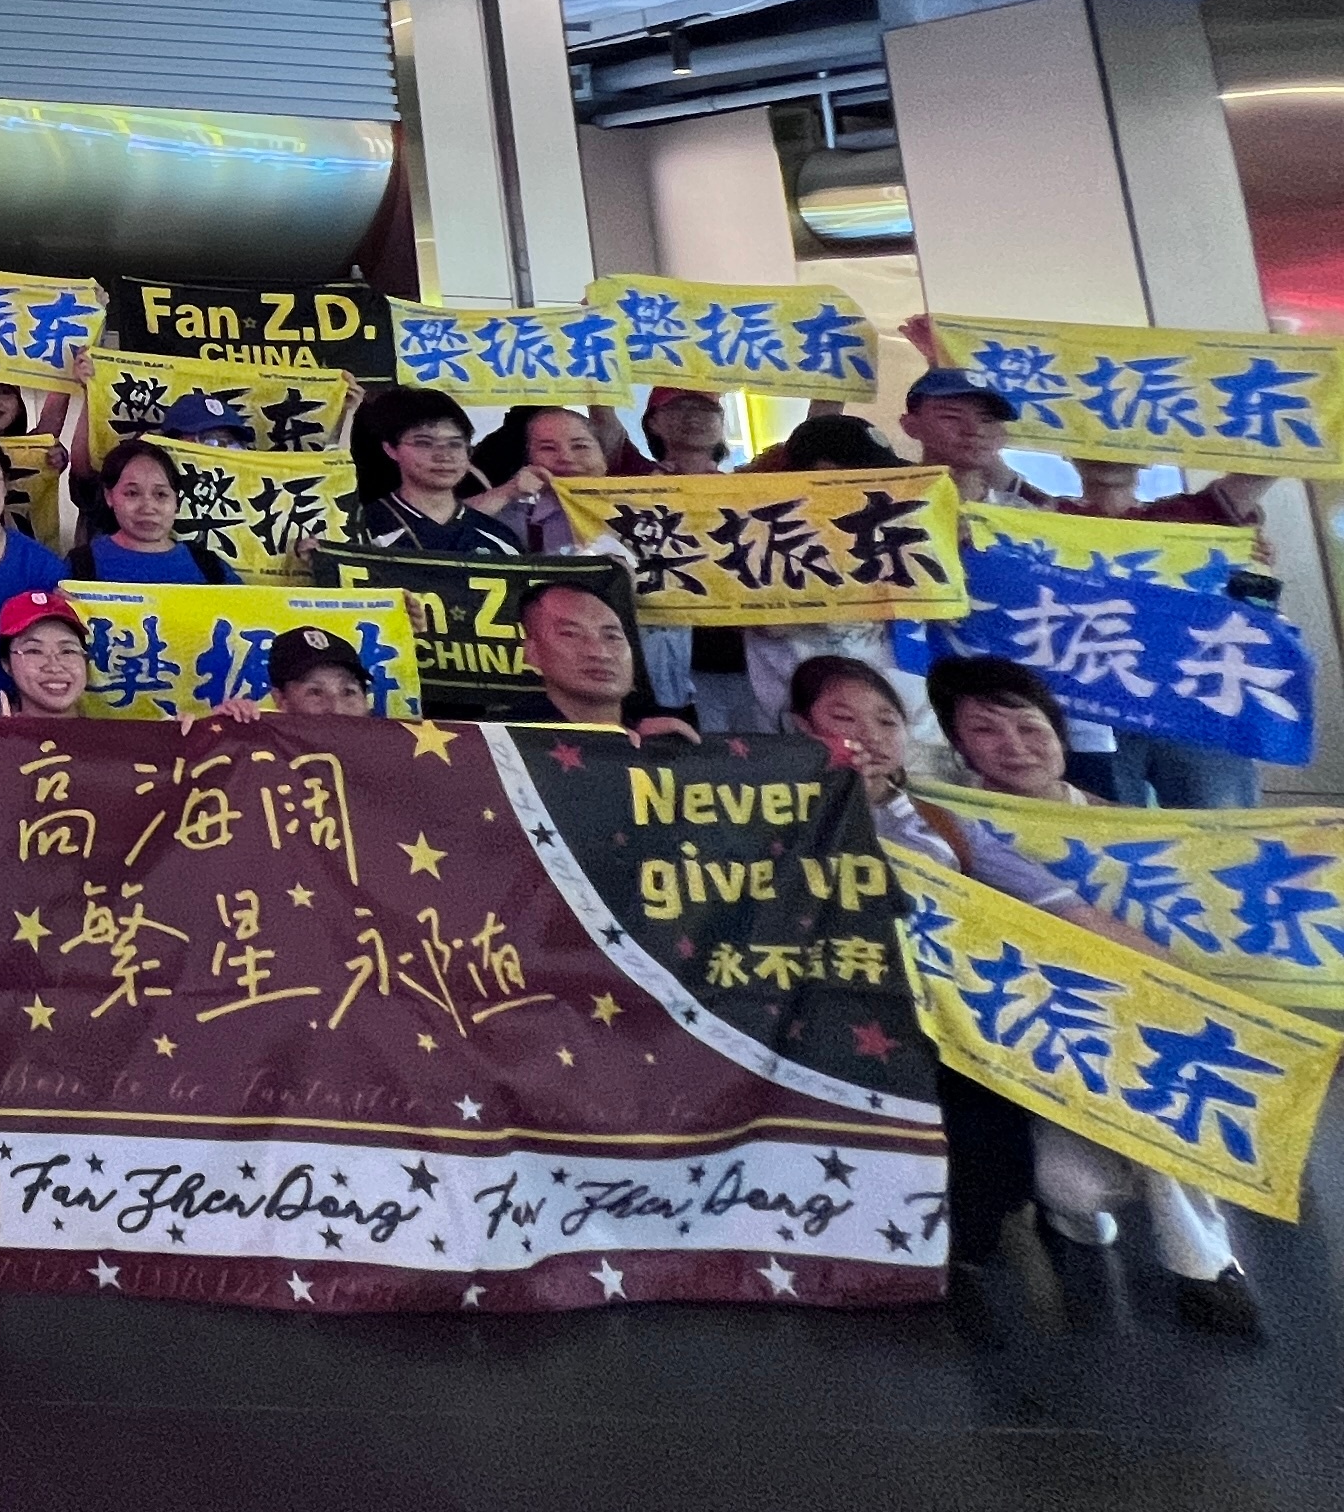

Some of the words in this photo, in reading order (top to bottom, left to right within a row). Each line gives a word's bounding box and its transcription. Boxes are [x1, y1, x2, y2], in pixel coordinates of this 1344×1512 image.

[141, 286, 240, 340] Fan
[260, 293, 377, 341] Z.D.
[199, 343, 320, 368] CHINA
[400, 315, 618, 383] 樊振东
[619, 289, 875, 380] 樊振东
[972, 339, 1323, 448] 樊振东
[172, 462, 360, 559] 樊振
[604, 490, 950, 596] 樊振东
[967, 587, 1301, 723] 振东
[627, 767, 822, 826] Never
[640, 840, 776, 921] give
[1043, 819, 1344, 968] 振东
[59, 880, 556, 1038] 繁星永随
[9, 1153, 118, 1215] Fan
